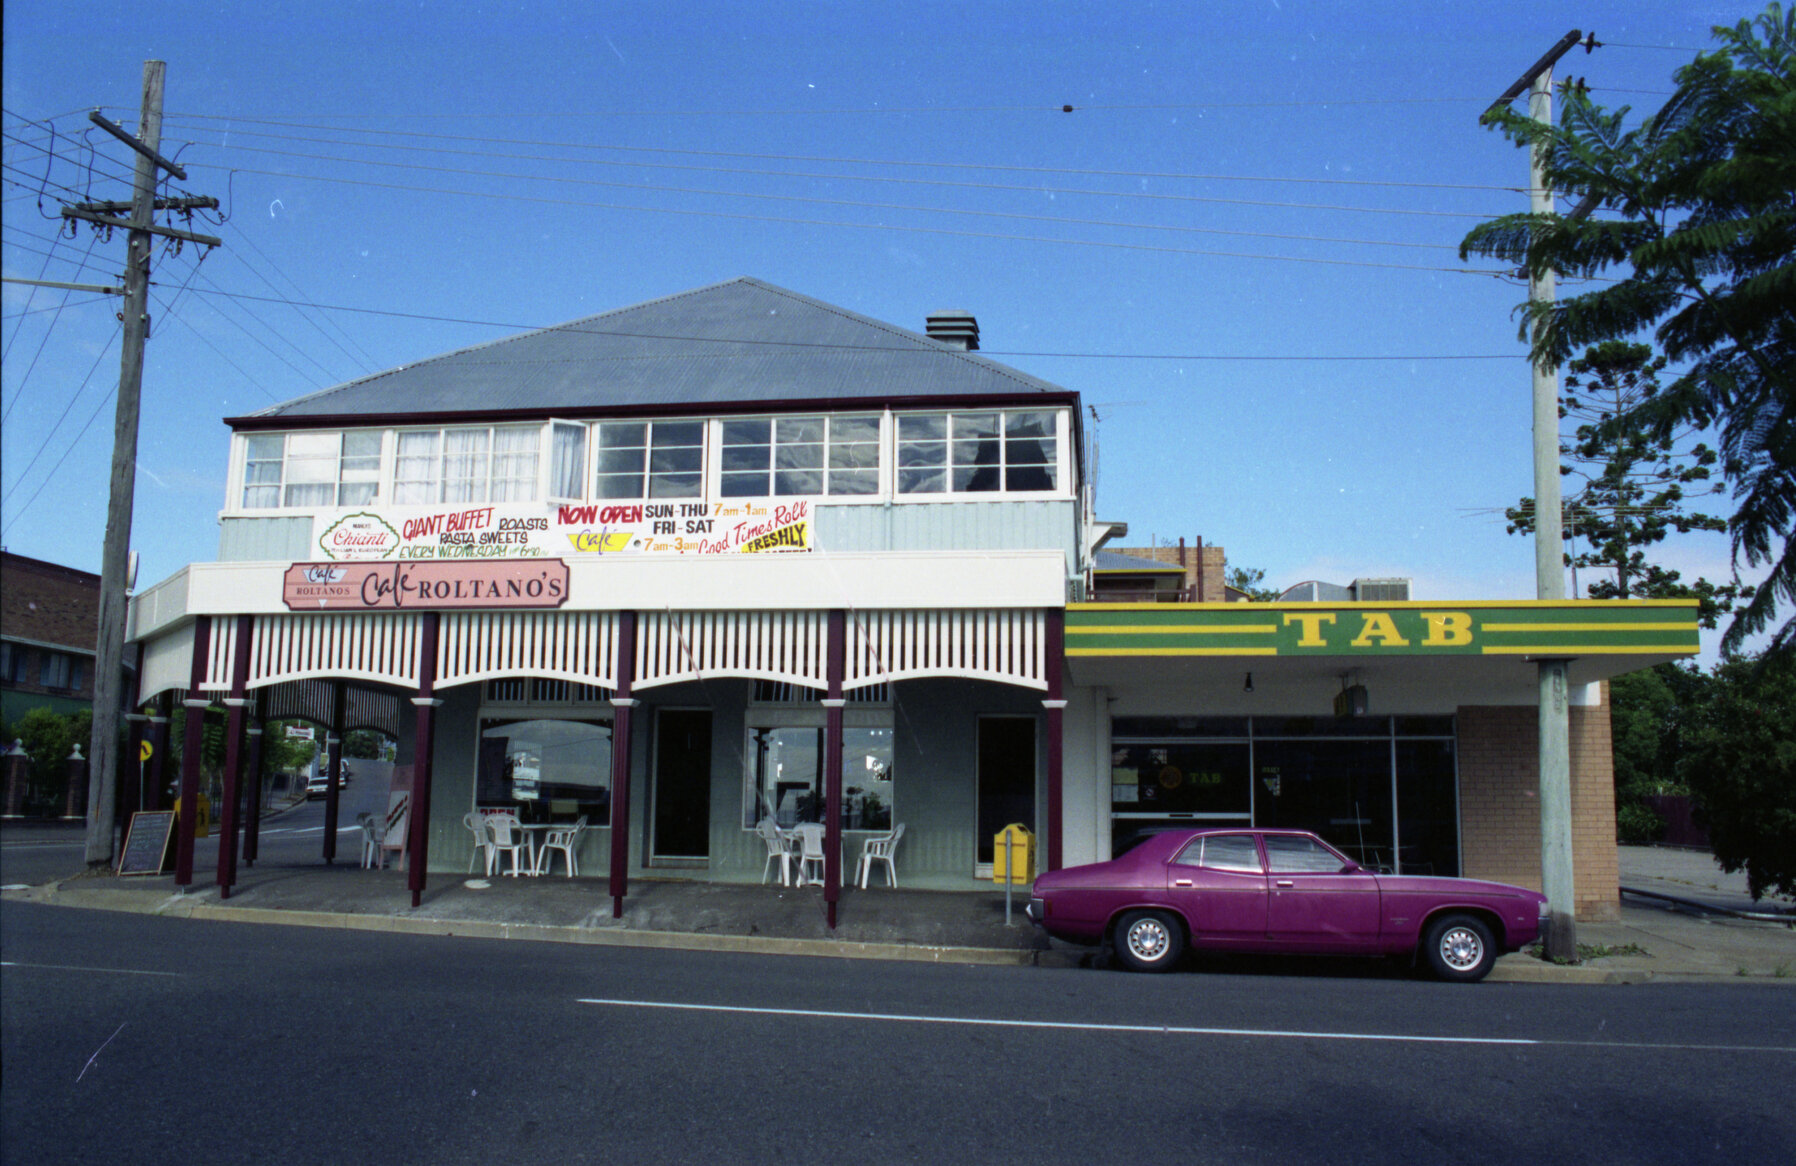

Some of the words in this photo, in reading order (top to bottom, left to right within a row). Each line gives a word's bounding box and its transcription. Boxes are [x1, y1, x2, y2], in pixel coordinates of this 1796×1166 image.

[402, 514, 445, 541] GIANT
[446, 507, 495, 533] BUFFET
[499, 518, 548, 530] ROASTS
[558, 504, 598, 525] NOW
[599, 504, 643, 524] OPEN
[733, 520, 773, 545] Times
[774, 501, 807, 529] Roll
[333, 528, 389, 546] Chianti
[440, 532, 475, 545] PASTA
[479, 531, 528, 545] SWEETS
[747, 523, 805, 551] FRESHLY
[399, 545, 434, 558] EVERY
[438, 544, 508, 558] WEDNESDAY
[361, 563, 418, 608] Café
[419, 571, 562, 599] ROLTANO'S
[1283, 611, 1474, 647] TAB
[1189, 772, 1222, 784] TAB
